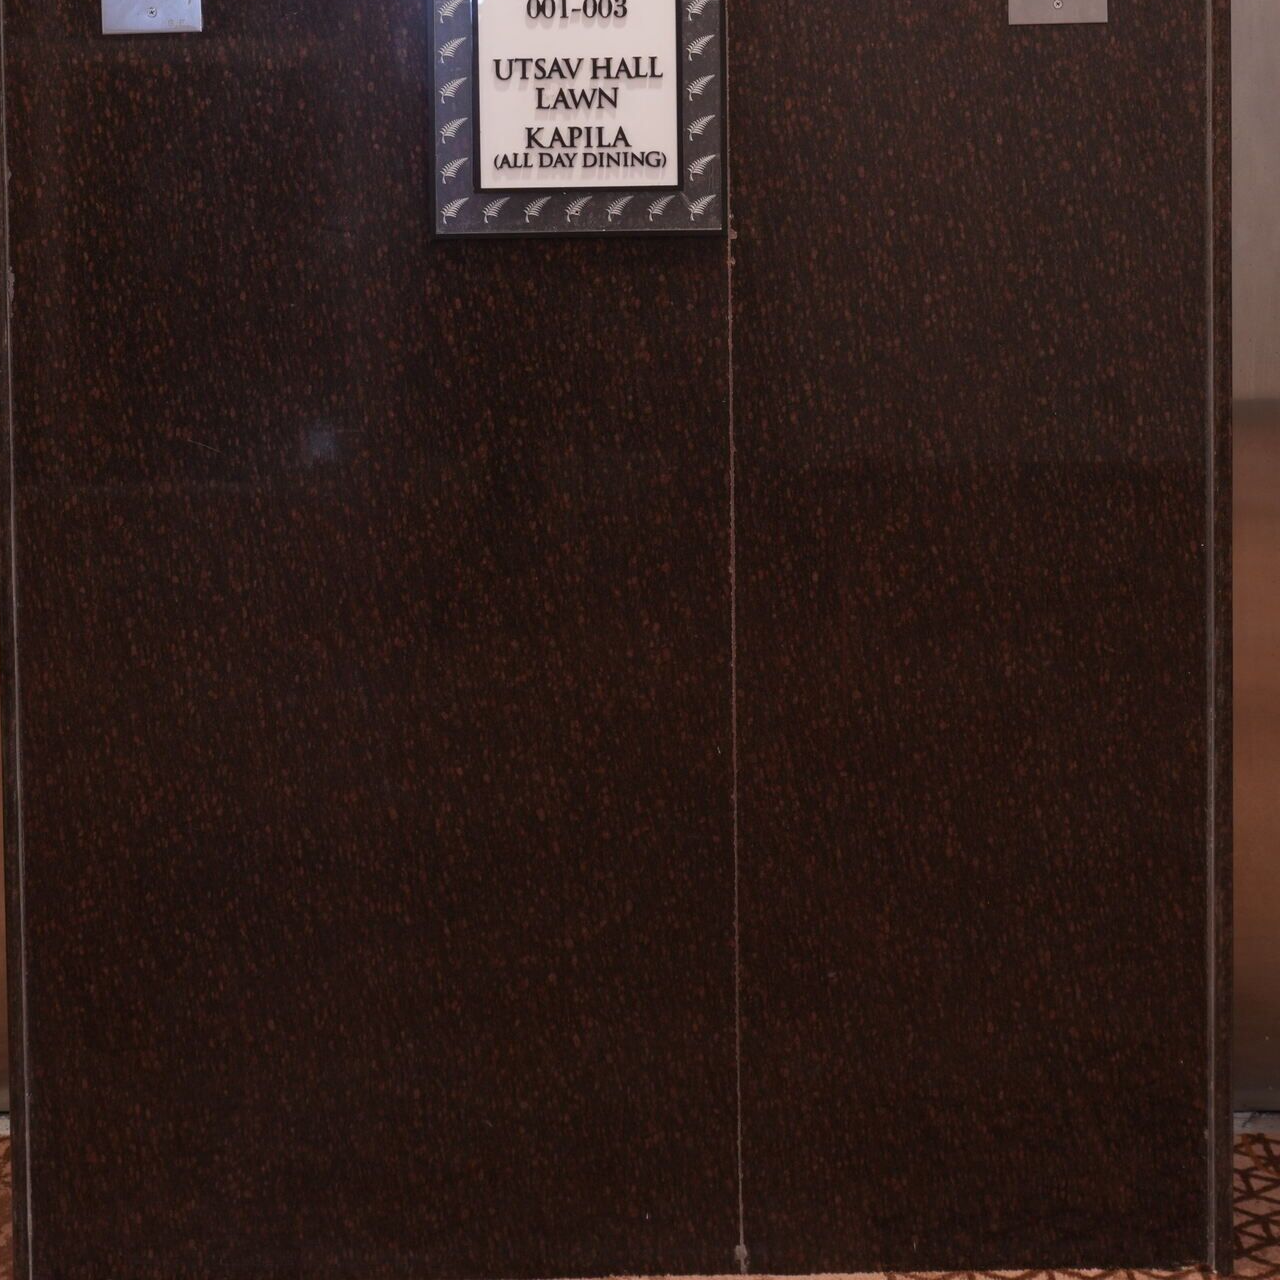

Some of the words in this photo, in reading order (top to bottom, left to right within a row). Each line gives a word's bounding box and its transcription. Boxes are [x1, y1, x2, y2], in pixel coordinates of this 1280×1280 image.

[492, 57, 584, 81] UTSAV
[591, 56, 663, 79] HALL
[535, 87, 619, 110] LAWN
[525, 126, 631, 148] KAPILA
[493, 152, 534, 169] (ALL
[539, 152, 579, 169] DAY
[582, 150, 667, 169] DINING)
